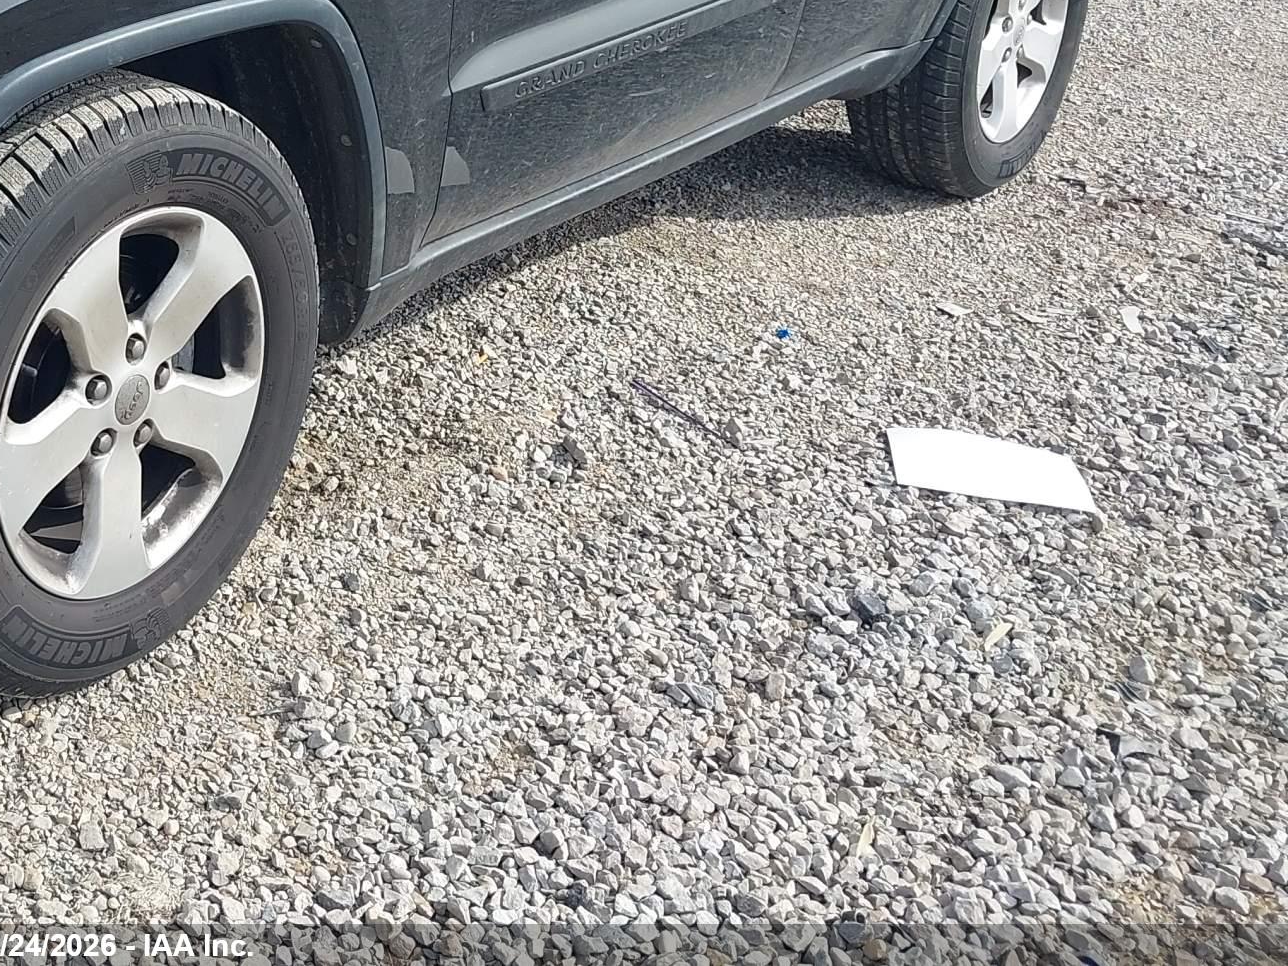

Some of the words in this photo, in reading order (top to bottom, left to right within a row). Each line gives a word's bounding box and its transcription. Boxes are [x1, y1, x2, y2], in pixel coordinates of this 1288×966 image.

[514, 60, 586, 99] GRAND
[593, 19, 689, 69] CHEROKEE
[175, 153, 288, 221] MICHELIN
[1, 615, 128, 665] MICHELIN
